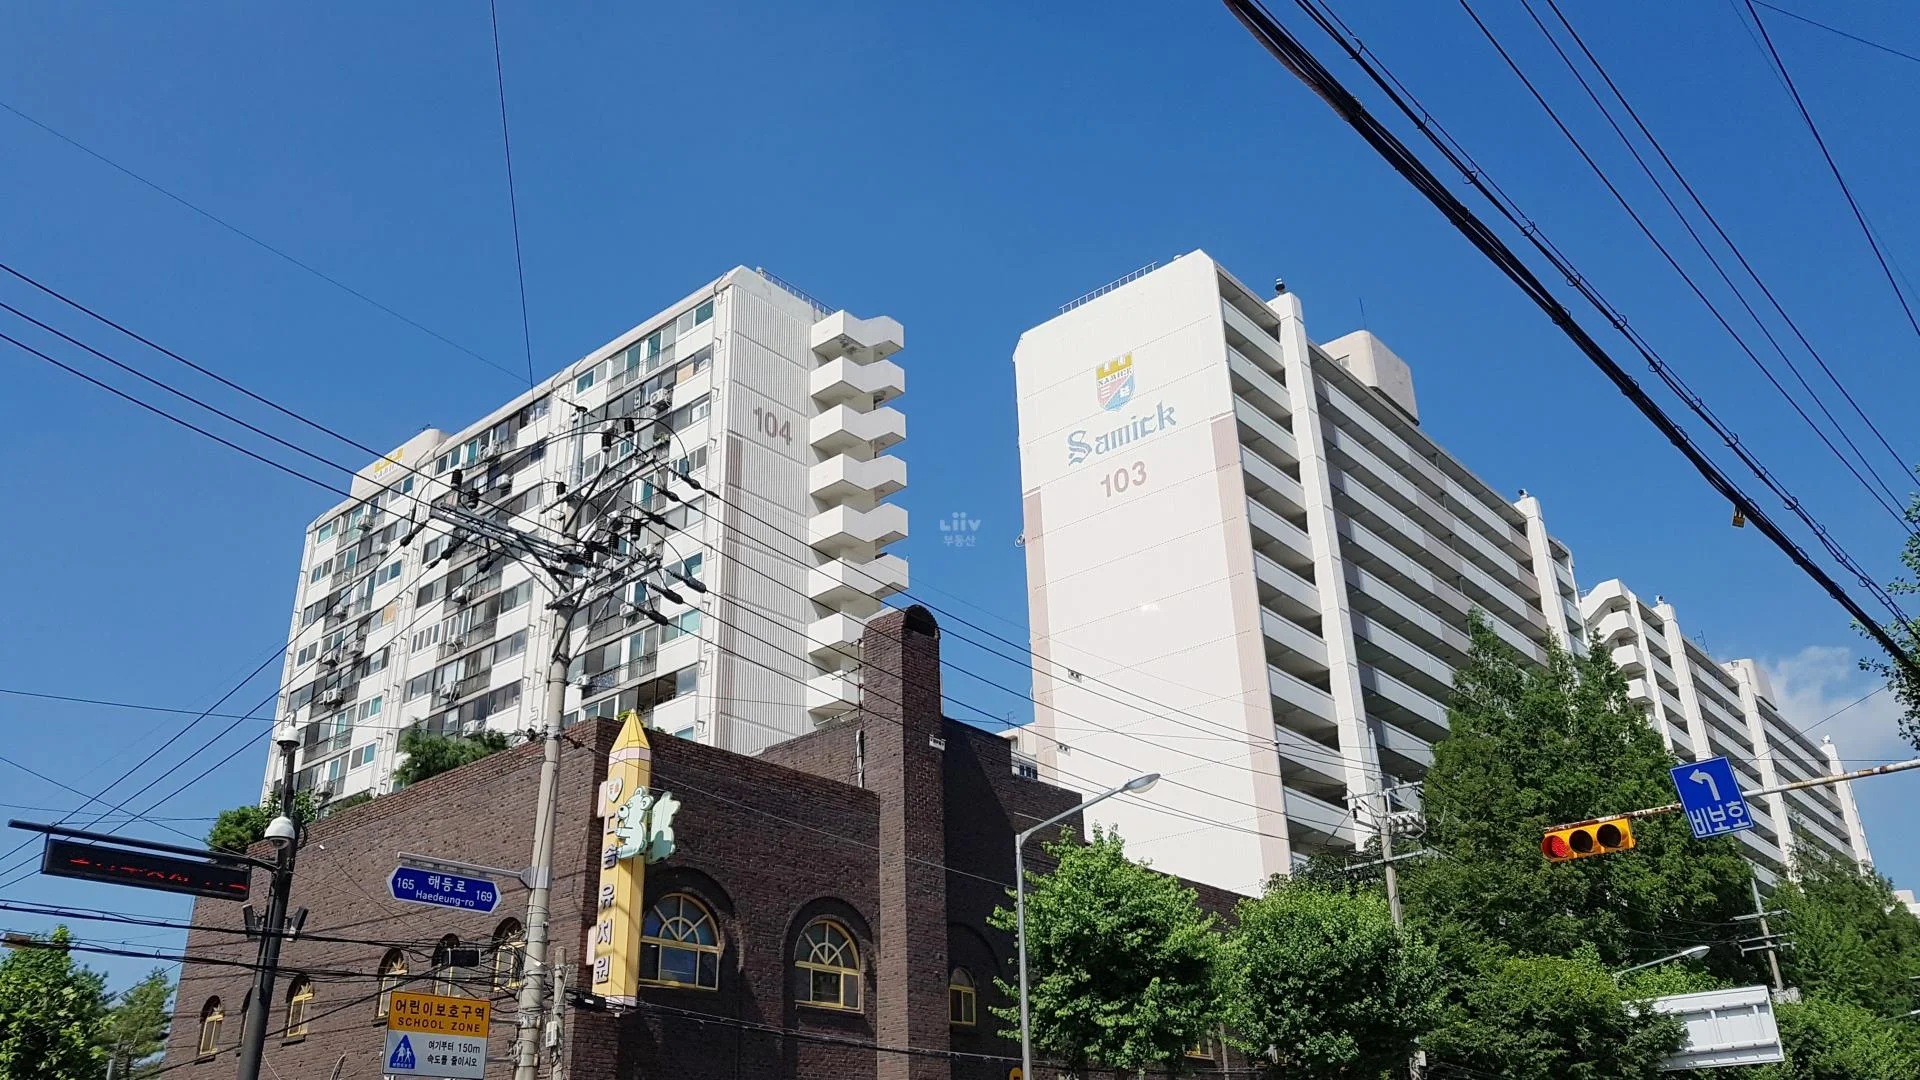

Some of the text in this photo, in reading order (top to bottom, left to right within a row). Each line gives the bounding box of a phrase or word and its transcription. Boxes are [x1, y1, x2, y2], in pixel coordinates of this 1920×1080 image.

[753, 406, 792, 446] 104
[1067, 400, 1177, 466] Samick
[1100, 461, 1147, 498] 103
[1689, 801, 1750, 835] 비보호
[397, 877, 415, 890] 165
[428, 875, 467, 893] 해등로
[415, 890, 475, 907] Haedeung-ro
[476, 890, 493, 902] 169
[395, 999, 485, 1021] 어린이보호구역
[397, 1017, 480, 1033] SCHOOL ZONE
[428, 1040, 480, 1054] 여기부터 150m
[427, 1053, 448, 1065] 속도를
[451, 1055, 478, 1067] 줄이시오
